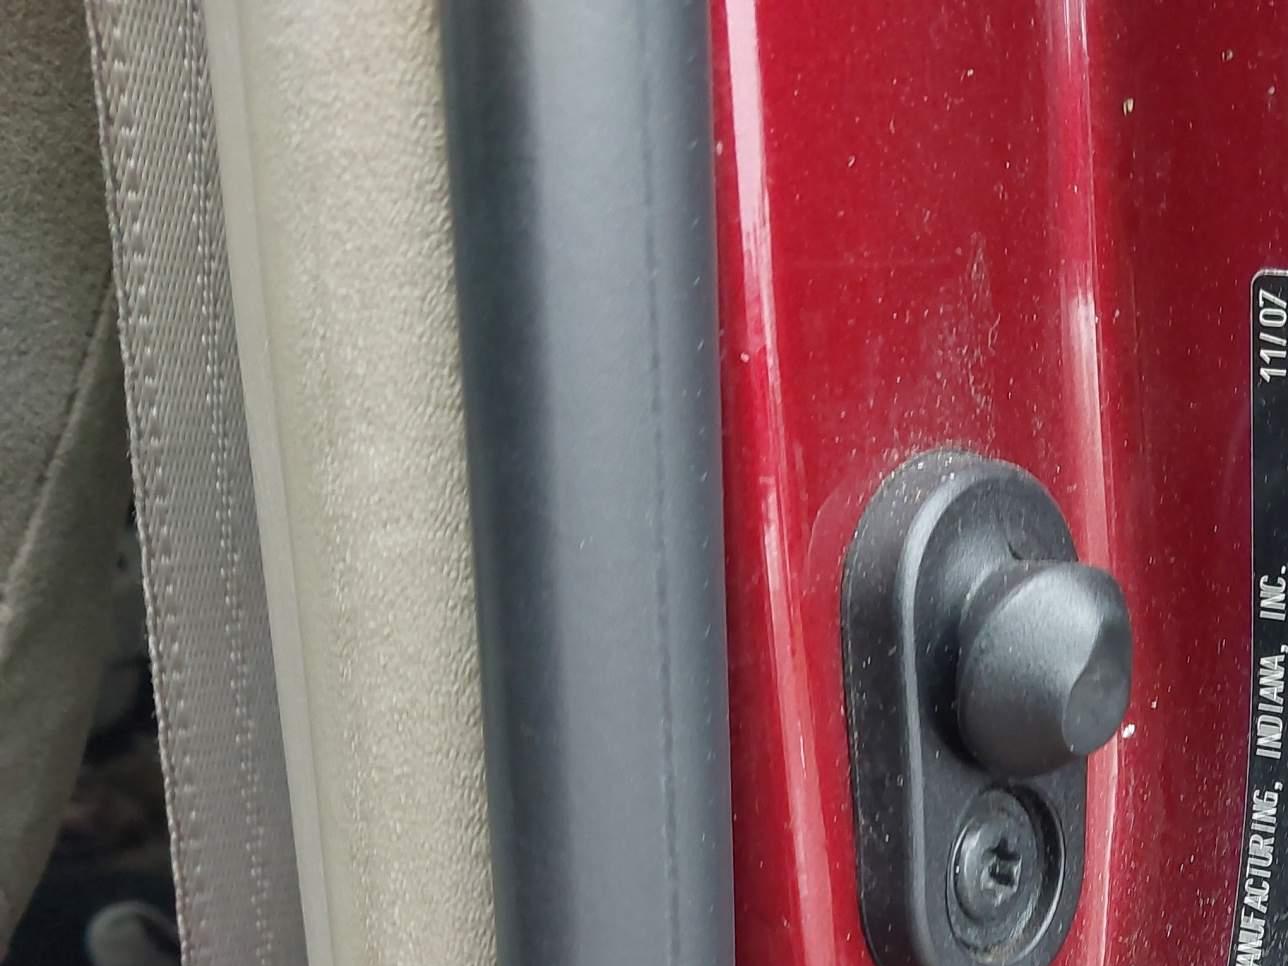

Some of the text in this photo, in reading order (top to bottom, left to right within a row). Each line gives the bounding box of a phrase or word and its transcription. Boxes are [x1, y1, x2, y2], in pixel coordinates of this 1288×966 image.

[1259, 289, 1287, 382] 11/07
[1260, 566, 1286, 621] INC.
[1256, 644, 1288, 759] INDIANA,
